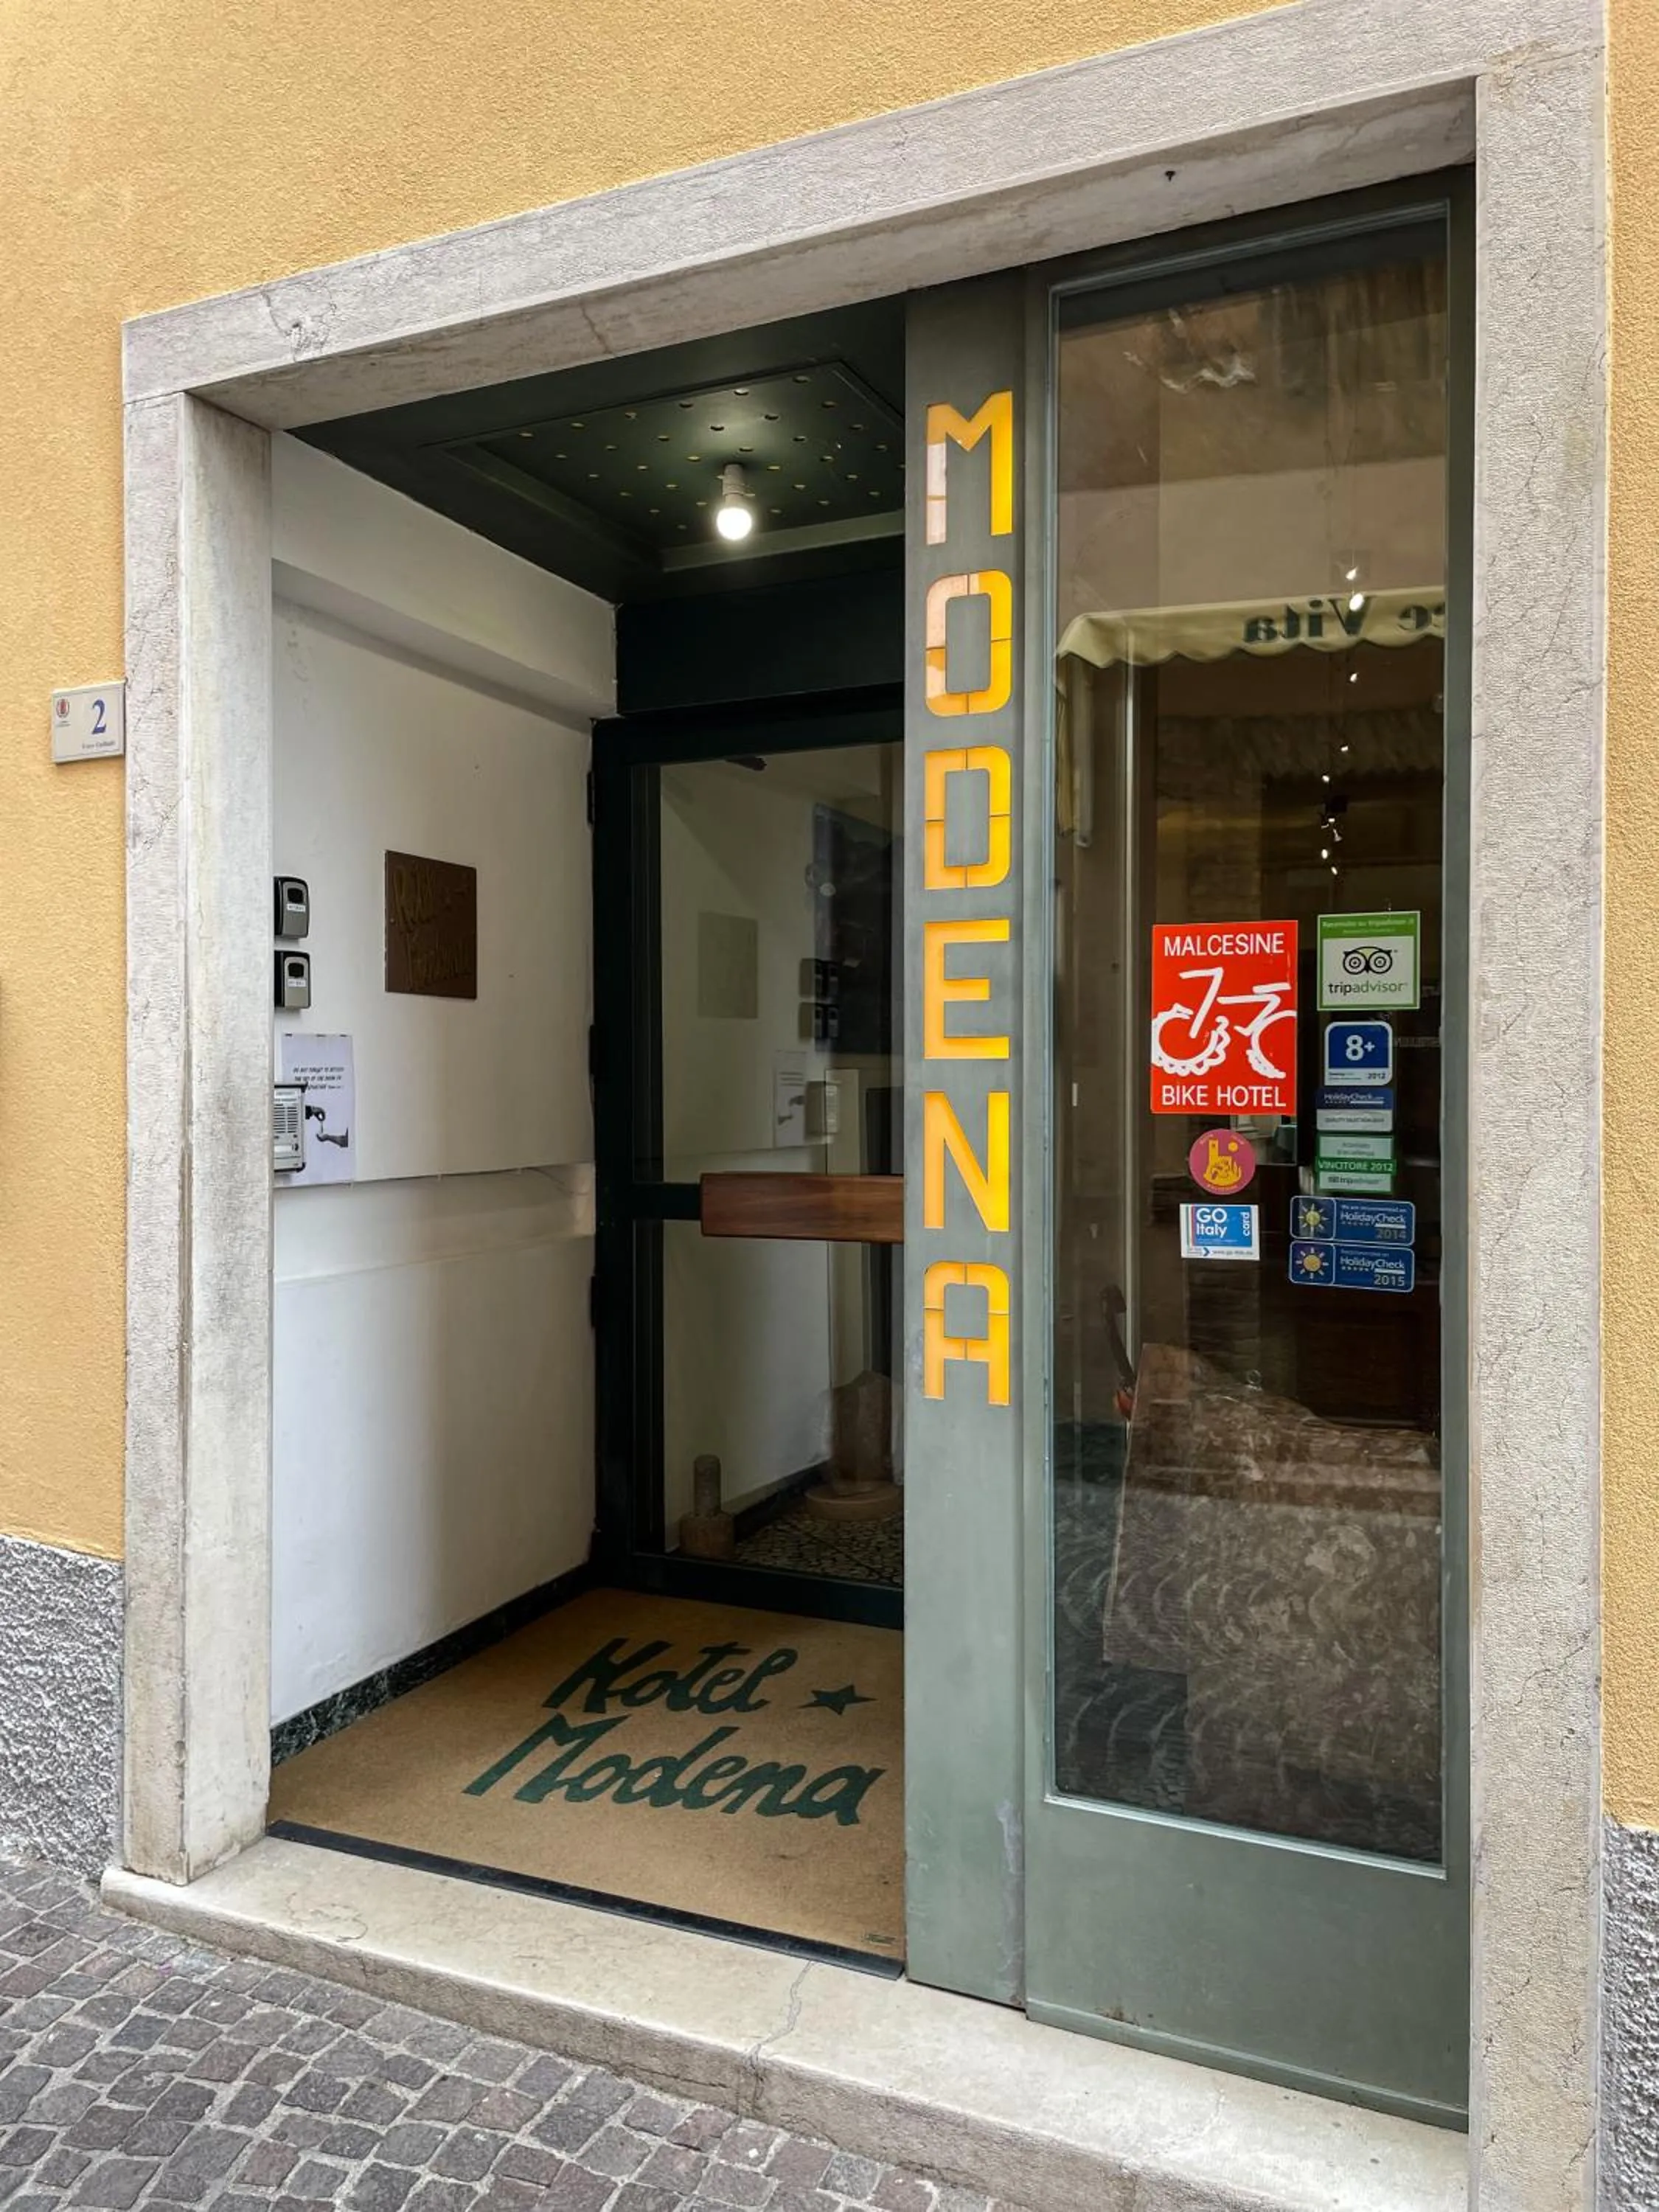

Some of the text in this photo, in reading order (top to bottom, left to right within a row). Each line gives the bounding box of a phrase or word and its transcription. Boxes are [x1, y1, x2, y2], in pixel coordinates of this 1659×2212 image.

[91, 699, 107, 734] 2
[924, 390, 1013, 1406] MODENA
[1164, 933, 1284, 956] MALCESINE
[1328, 981, 1405, 996] tripadvisor
[1346, 1034, 1376, 1061] 8+
[1162, 1085, 1287, 1107] BIKE HOTEL
[1371, 1162, 1393, 1172] 2012
[1197, 1207, 1228, 1223] GO
[1240, 1211, 1251, 1237] card
[1340, 1211, 1405, 1225] HolidayCheck
[1196, 1223, 1228, 1239] Italy
[1339, 1256, 1405, 1270] HolidayCheck
[1374, 1274, 1405, 1287] 2015
[542, 1638, 799, 1714] Hotel
[462, 1712, 889, 1826] Modena
